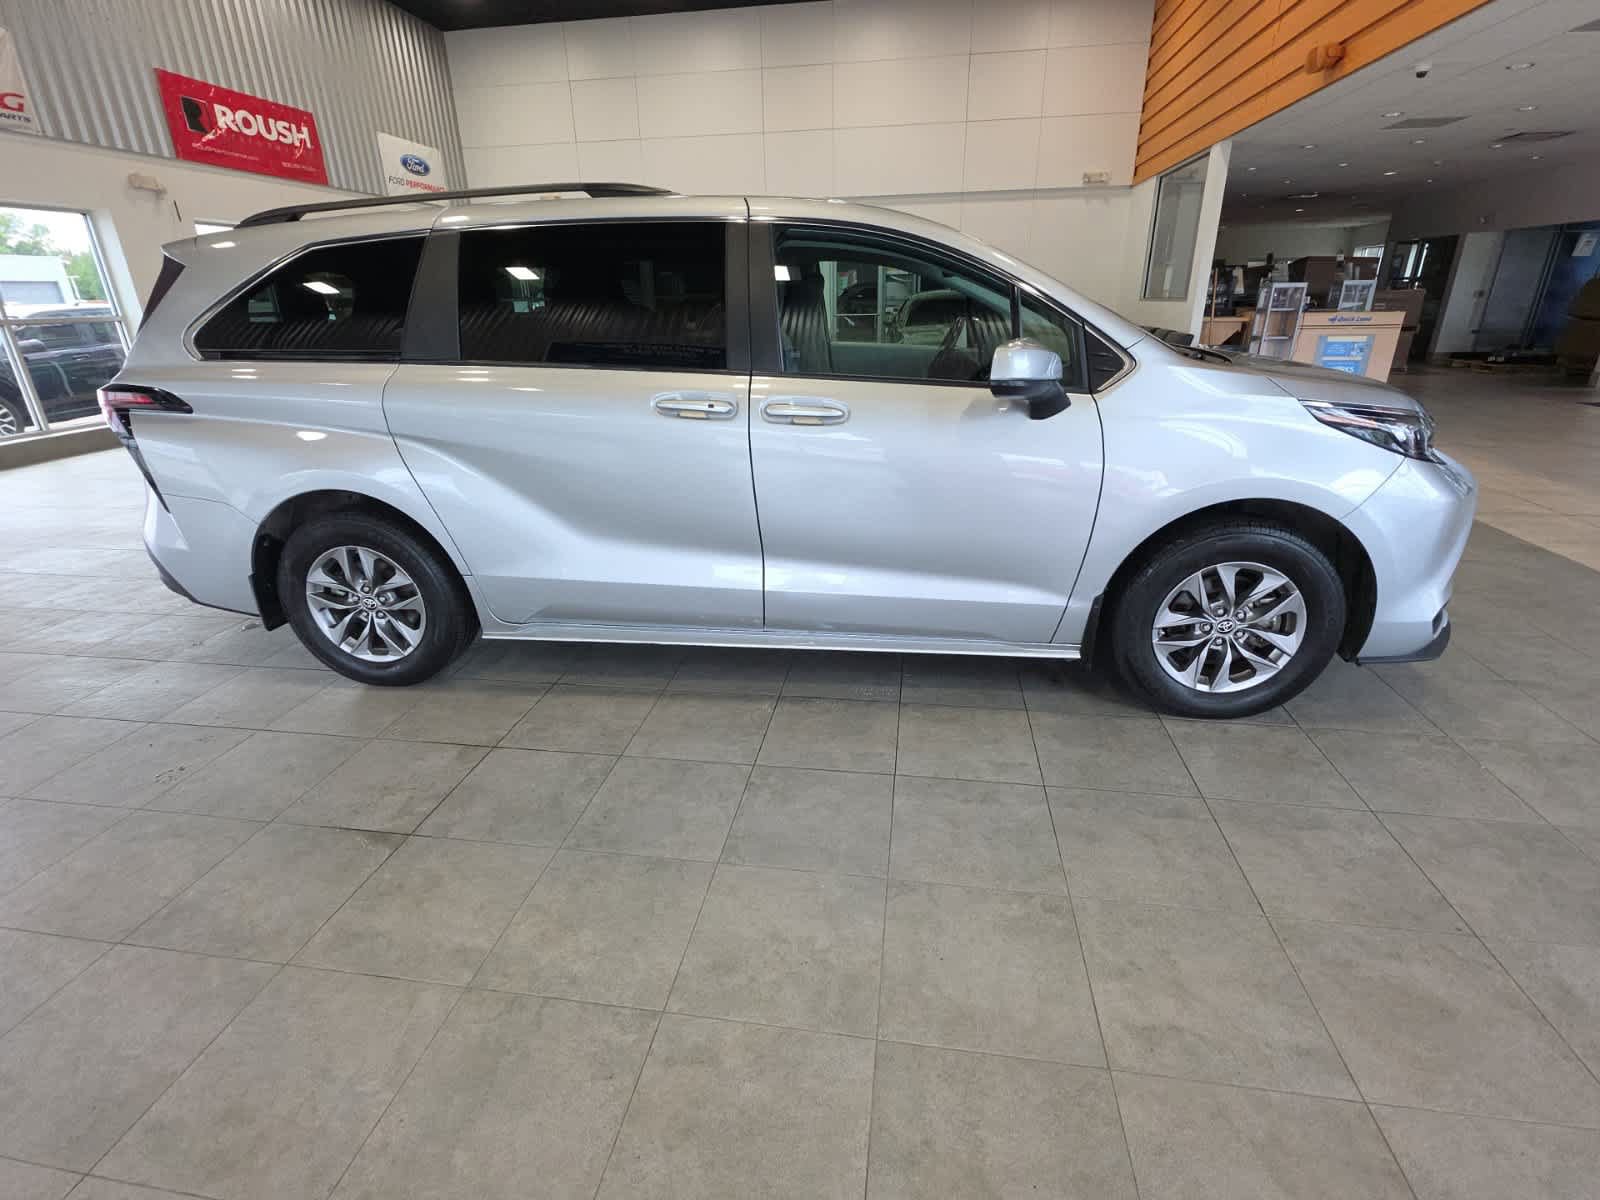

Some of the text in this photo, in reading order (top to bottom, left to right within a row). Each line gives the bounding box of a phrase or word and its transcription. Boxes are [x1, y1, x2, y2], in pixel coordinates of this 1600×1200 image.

[213, 103, 312, 149] ROUSH
[407, 157, 425, 173] Ford
[388, 175, 405, 186] FORD
